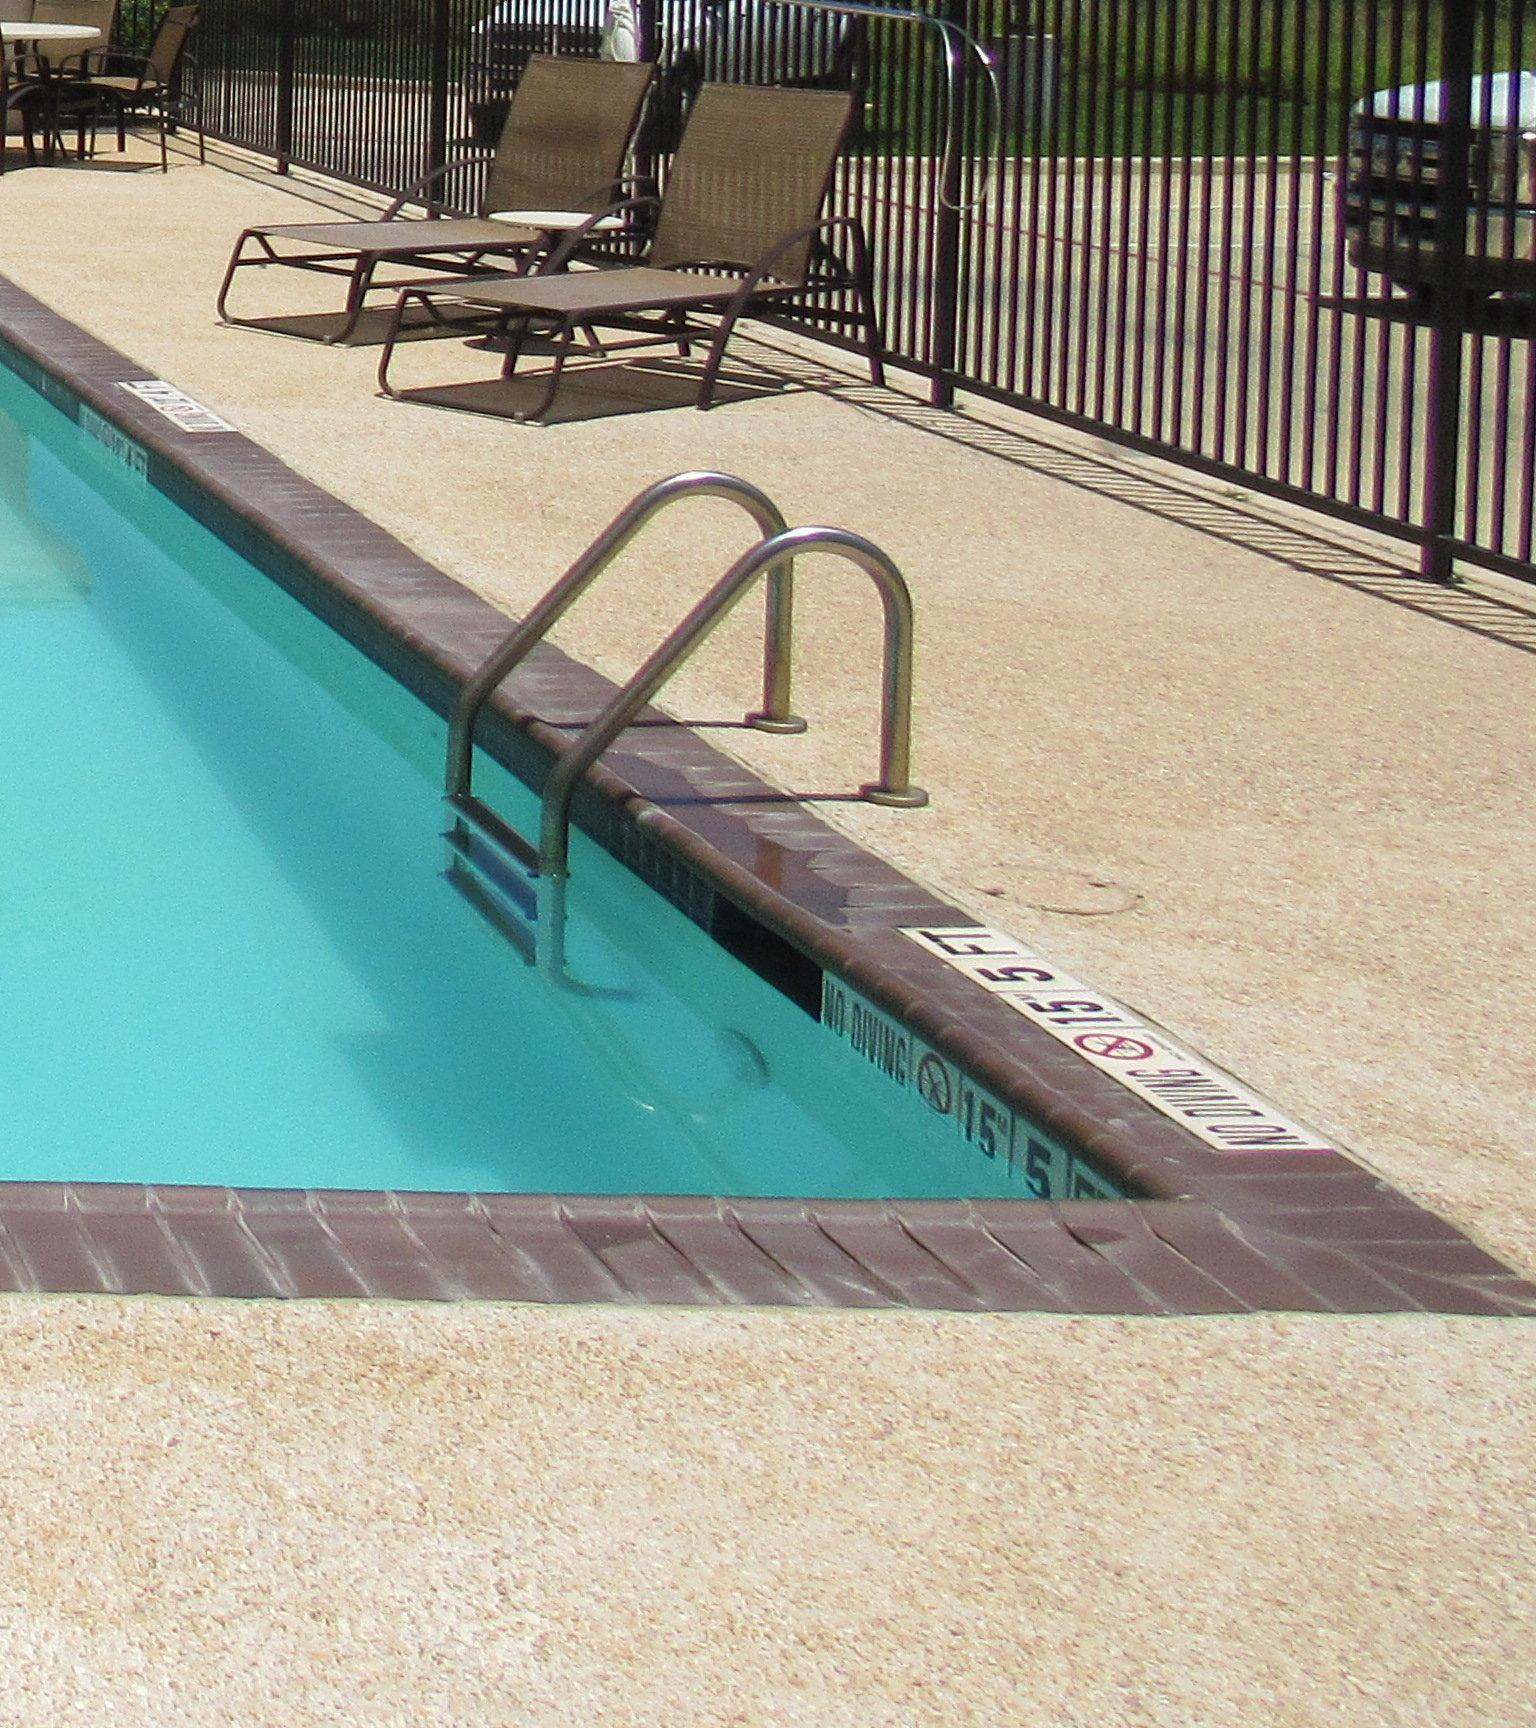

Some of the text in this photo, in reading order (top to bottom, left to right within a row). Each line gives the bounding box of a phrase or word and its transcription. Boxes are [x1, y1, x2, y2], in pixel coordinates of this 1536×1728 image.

[916, 929, 1019, 956] FT
[975, 966, 1056, 983] 5
[1125, 1068, 1266, 1118] DIVING
[1206, 1124, 1309, 1146] NO
